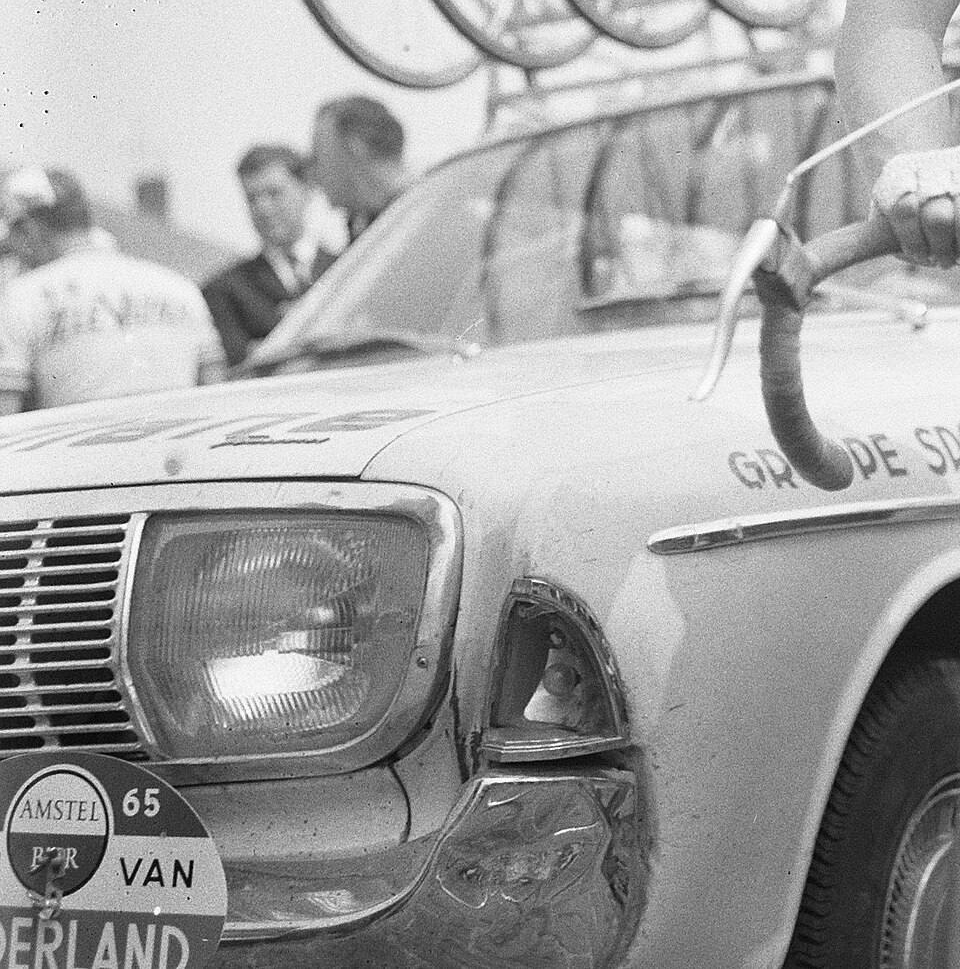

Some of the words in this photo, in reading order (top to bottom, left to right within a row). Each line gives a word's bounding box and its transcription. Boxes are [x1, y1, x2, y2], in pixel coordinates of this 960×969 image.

[728, 433, 908, 490] GRPE
[19, 798, 100, 823] AMSTEL
[122, 787, 161, 817] 65
[31, 845, 80, 871] BR
[119, 856, 195, 888] VAN
[0, 915, 190, 969] ERLAND
